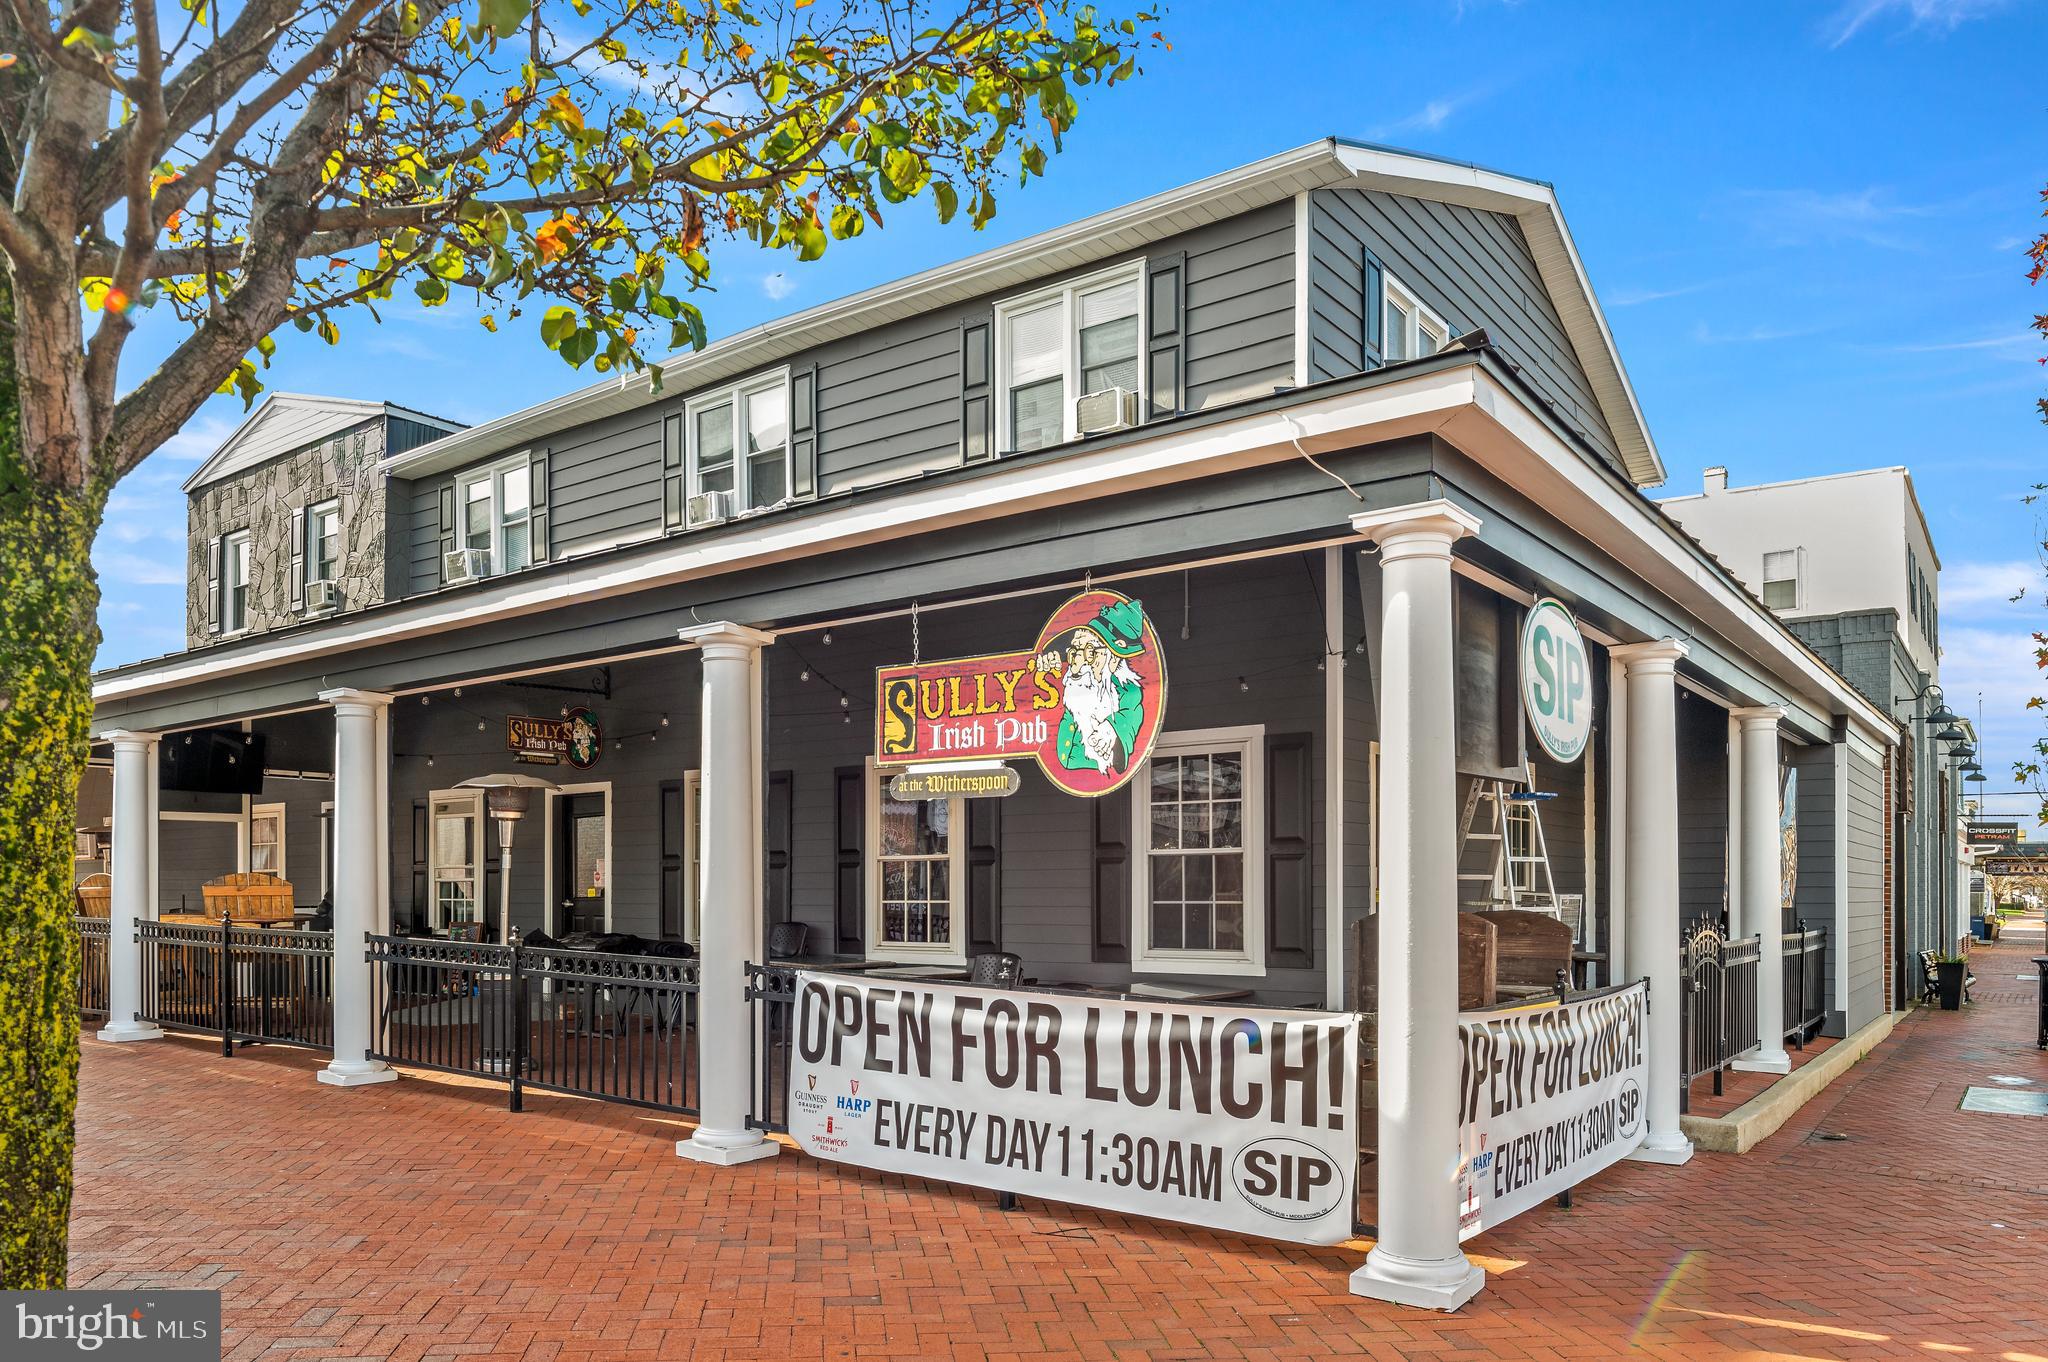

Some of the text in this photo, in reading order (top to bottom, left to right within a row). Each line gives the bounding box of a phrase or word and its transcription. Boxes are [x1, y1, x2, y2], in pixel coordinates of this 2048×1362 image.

[1533, 625, 1584, 724] SIP
[885, 658, 1062, 752] SULLY'S
[511, 720, 573, 746] SULLY'S
[526, 737, 567, 750] Irish Pub
[928, 713, 1048, 751] Irish Pub
[898, 773, 1008, 795] at the Witherspoon
[798, 981, 1345, 1130] OPEN FOR LUNCH!
[1527, 1008, 1575, 1104] FOR
[1576, 991, 1643, 1087] LUNCH!
[795, 1090, 828, 1103] GUINNESS
[836, 1095, 872, 1112] HARP
[844, 1111, 862, 1119] LAGER
[1619, 1088, 1639, 1128] SIP
[874, 1098, 977, 1160] EVERY
[1243, 1149, 1332, 1203] SIP
[1473, 1151, 1493, 1173] HARP
[1494, 1129, 1543, 1199] EVERY
